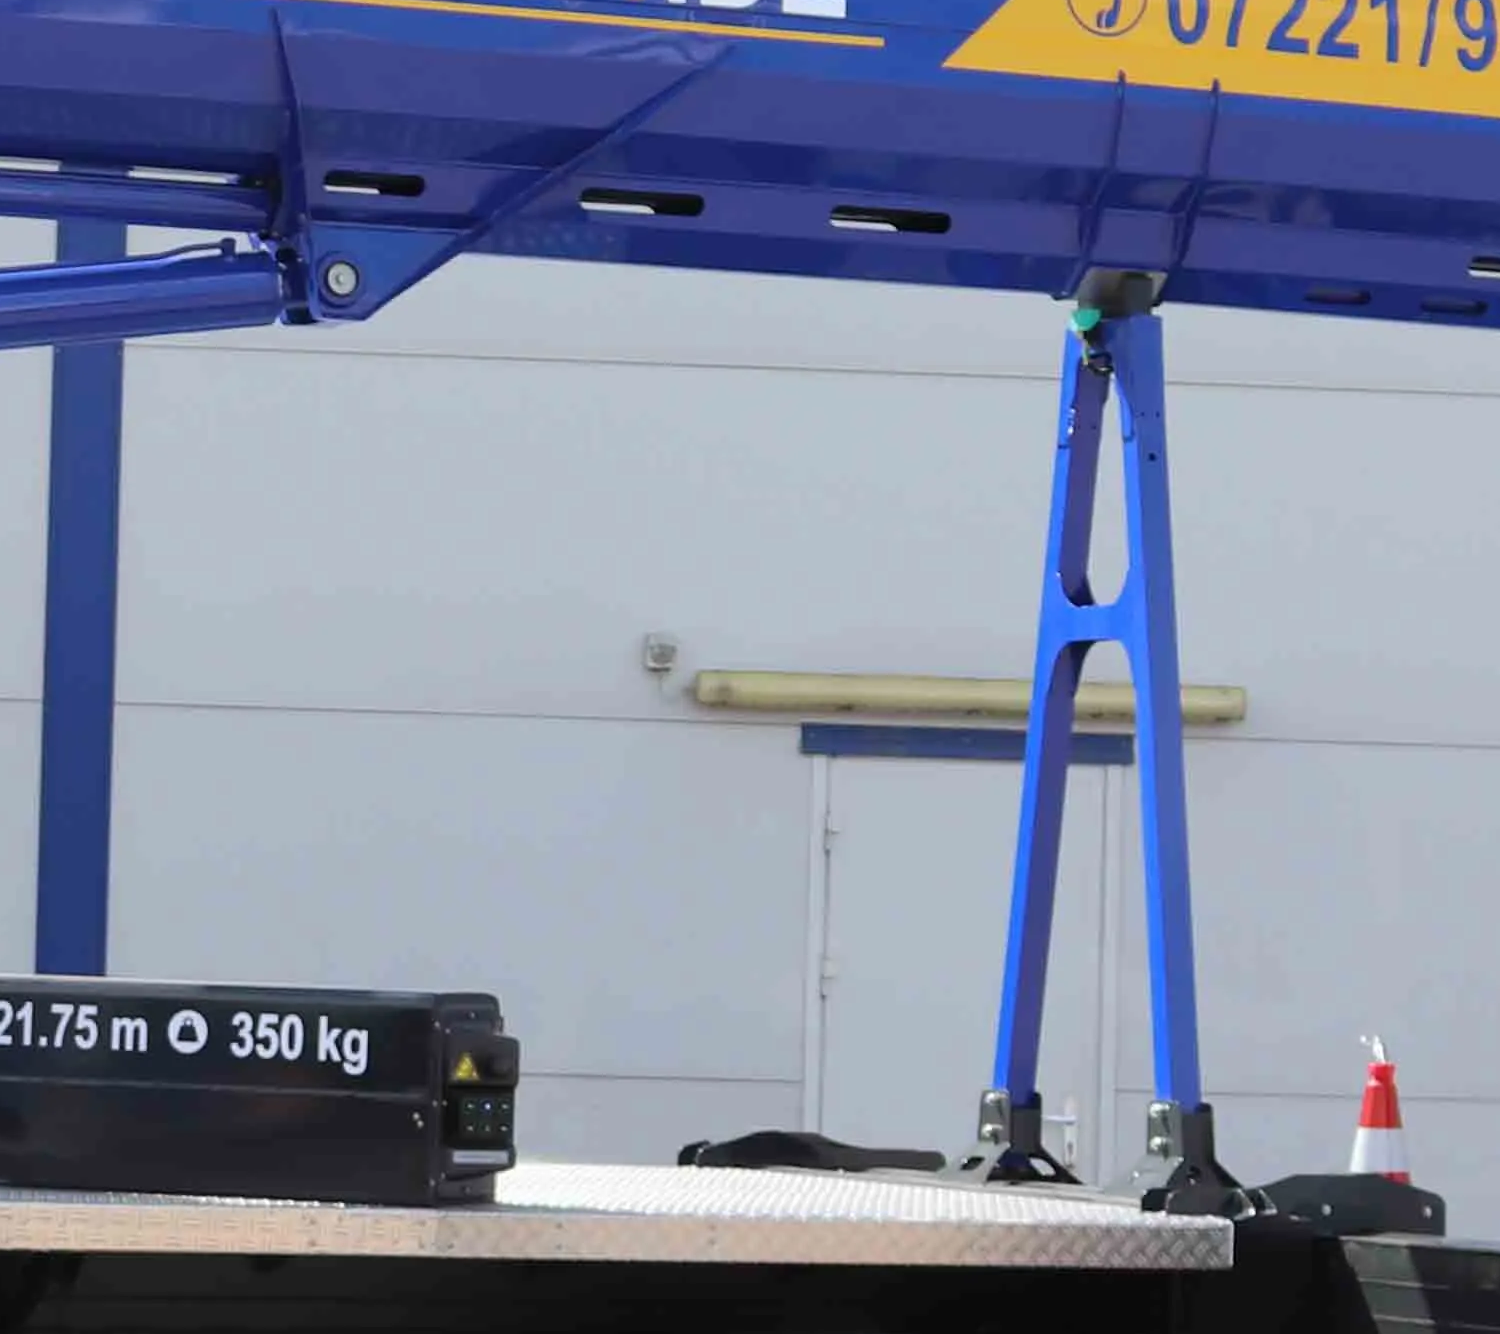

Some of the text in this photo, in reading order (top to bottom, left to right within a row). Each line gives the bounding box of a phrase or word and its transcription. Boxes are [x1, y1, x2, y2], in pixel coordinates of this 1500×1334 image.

[110, 1016, 148, 1053] m
[230, 1012, 304, 1061] 350
[318, 1015, 369, 1075] kg
